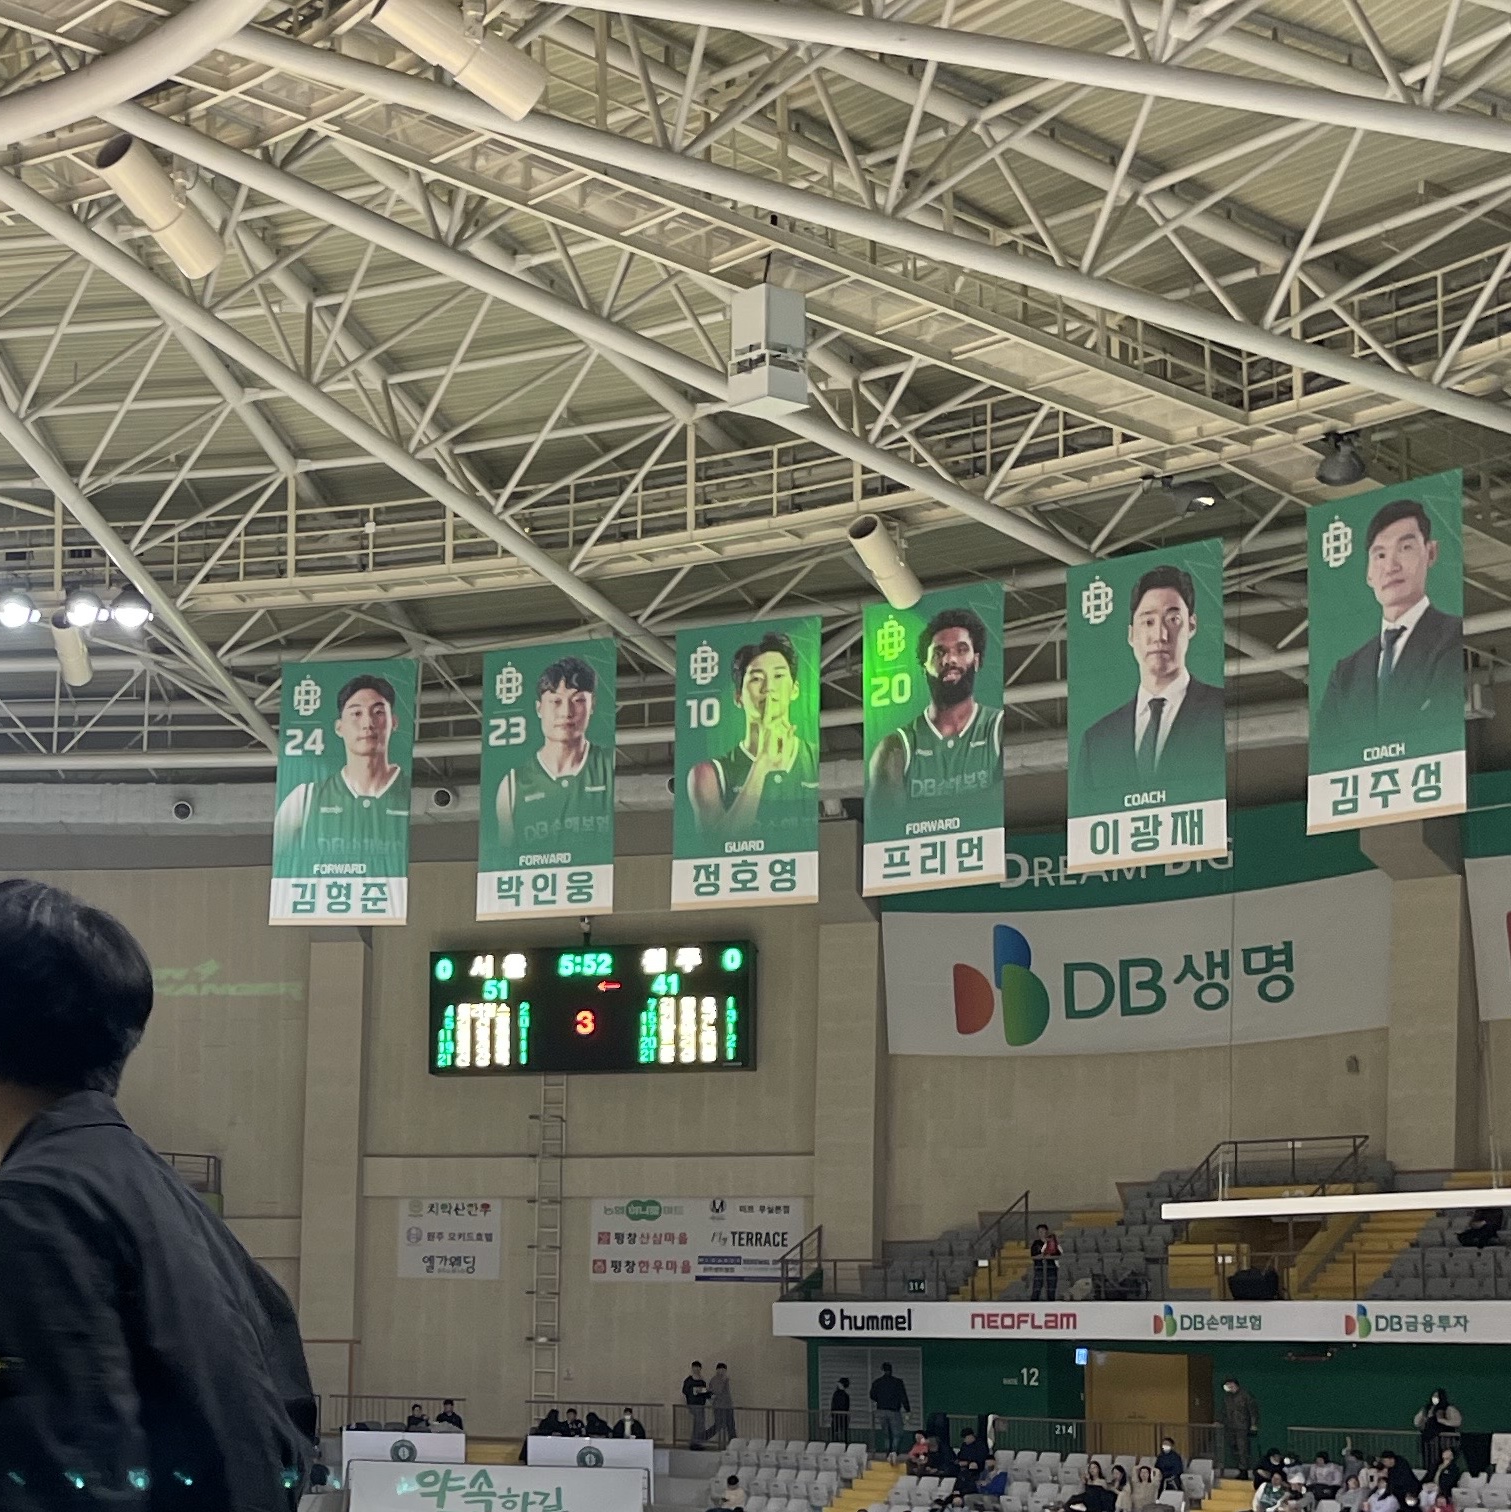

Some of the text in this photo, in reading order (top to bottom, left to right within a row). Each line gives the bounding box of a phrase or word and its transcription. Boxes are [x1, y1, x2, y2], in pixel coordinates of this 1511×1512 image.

[870, 673, 912, 707] 20
[687, 698, 720, 729] 10
[285, 729, 324, 756] 24
[489, 717, 527, 747] 23
[1363, 743, 1406, 762] COACH
[1123, 789, 1166, 807] COACH
[1329, 761, 1442, 815] 김주성
[906, 817, 960, 835] FORWARD
[1089, 808, 1205, 856] 이광재
[724, 840, 765, 853] GUARD
[882, 836, 983, 879] 프리먼
[313, 863, 367, 875] FORWARD
[519, 852, 572, 866] FORWARD
[693, 858, 797, 896] 정호영
[292, 881, 388, 913] 김형준
[497, 871, 594, 907] 박인웅
[435, 958, 454, 981] 0
[558, 953, 613, 977] 5:52
[721, 947, 743, 971] 0
[482, 979, 510, 1000] 51
[651, 973, 680, 995] 41
[1063, 940, 1295, 1020] DB생명
[576, 1010, 595, 1034] 3
[731, 1231, 788, 1247] TERRACE
[909, 1282, 925, 1292] 314
[840, 1308, 912, 1331] hummel
[1180, 1314, 1262, 1332] DB손해보험
[1375, 1315, 1469, 1333] DB금융투자
[1020, 1368, 1039, 1386] 12
